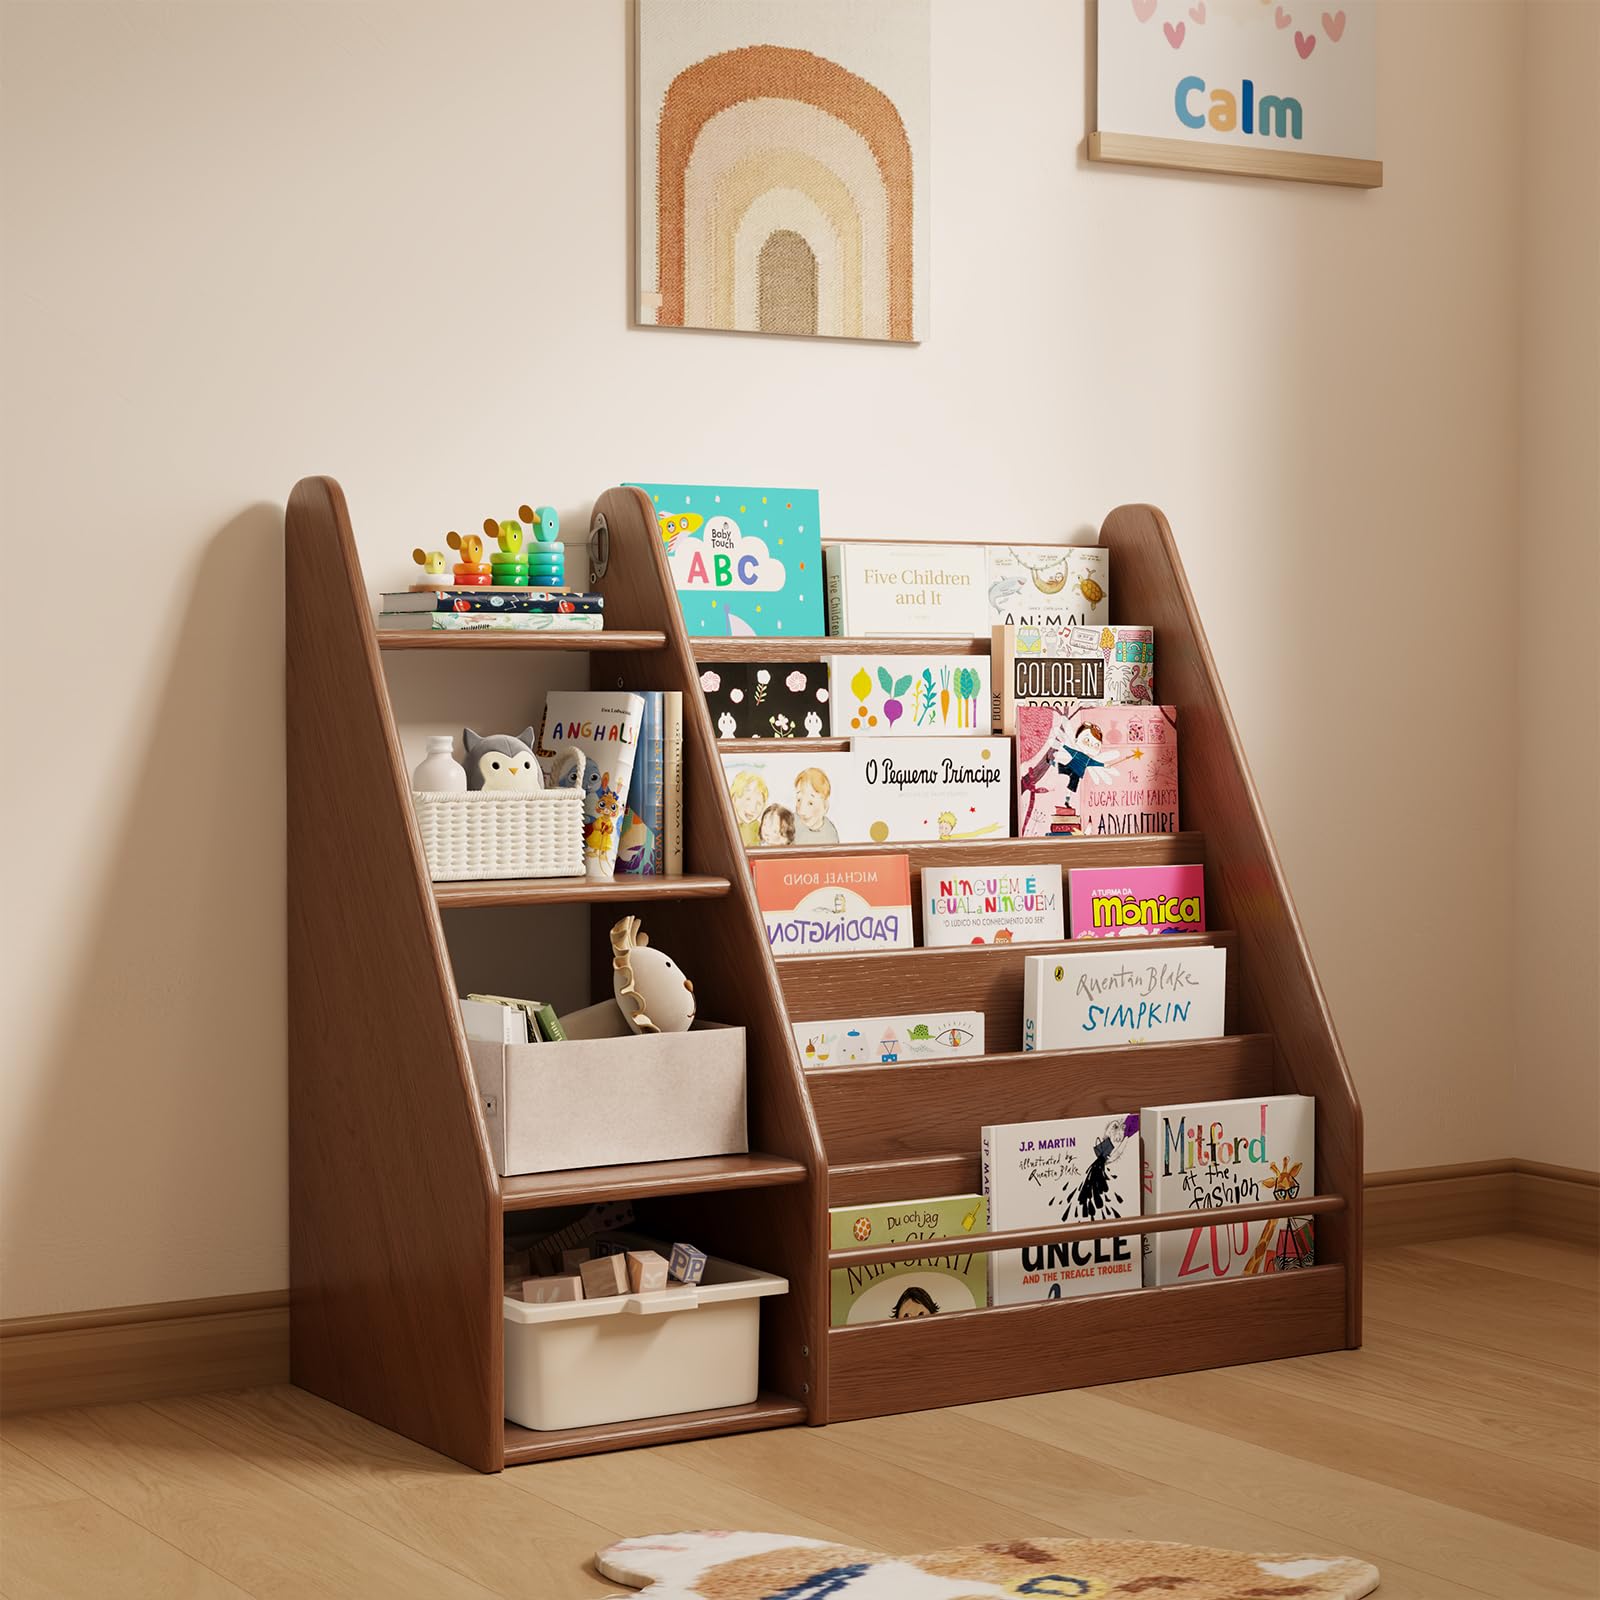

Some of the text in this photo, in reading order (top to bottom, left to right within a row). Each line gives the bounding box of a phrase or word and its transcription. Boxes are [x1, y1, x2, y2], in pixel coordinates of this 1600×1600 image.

[1174, 75, 1303, 140] Calm
[711, 528, 732, 541] Baby
[711, 538, 735, 549] Touch
[687, 551, 759, 587] ABC
[864, 569, 971, 586] Five Children
[830, 574, 842, 637] Five Children
[895, 590, 942, 605] and It
[992, 692, 1001, 721] BOOK
[865, 757, 1001, 791] O Pequeno Príncipe
[1088, 790, 1119, 807] SUGAR
[1121, 789, 1144, 807] PLUM
[1097, 888, 1121, 897] TURMA
[1122, 887, 1133, 896] DA
[931, 896, 976, 915] IGUAL
[972, 918, 981, 927] NO
[1025, 915, 1033, 925] DO
[1076, 962, 1199, 1001] Quentin Blake
[1082, 1001, 1191, 1031] SIMPKIN
[1019, 1137, 1076, 1152] J.P. MARTIN
[1162, 1104, 1269, 1177] Mitford
[1019, 1153, 1061, 1170] illustrated
[1182, 1163, 1230, 1191] at the
[887, 1210, 939, 1230] Du och jag
[1022, 1236, 1131, 1272] UNCLE
[1023, 1263, 1132, 1285] AND THE TREACLE TROUBLE
